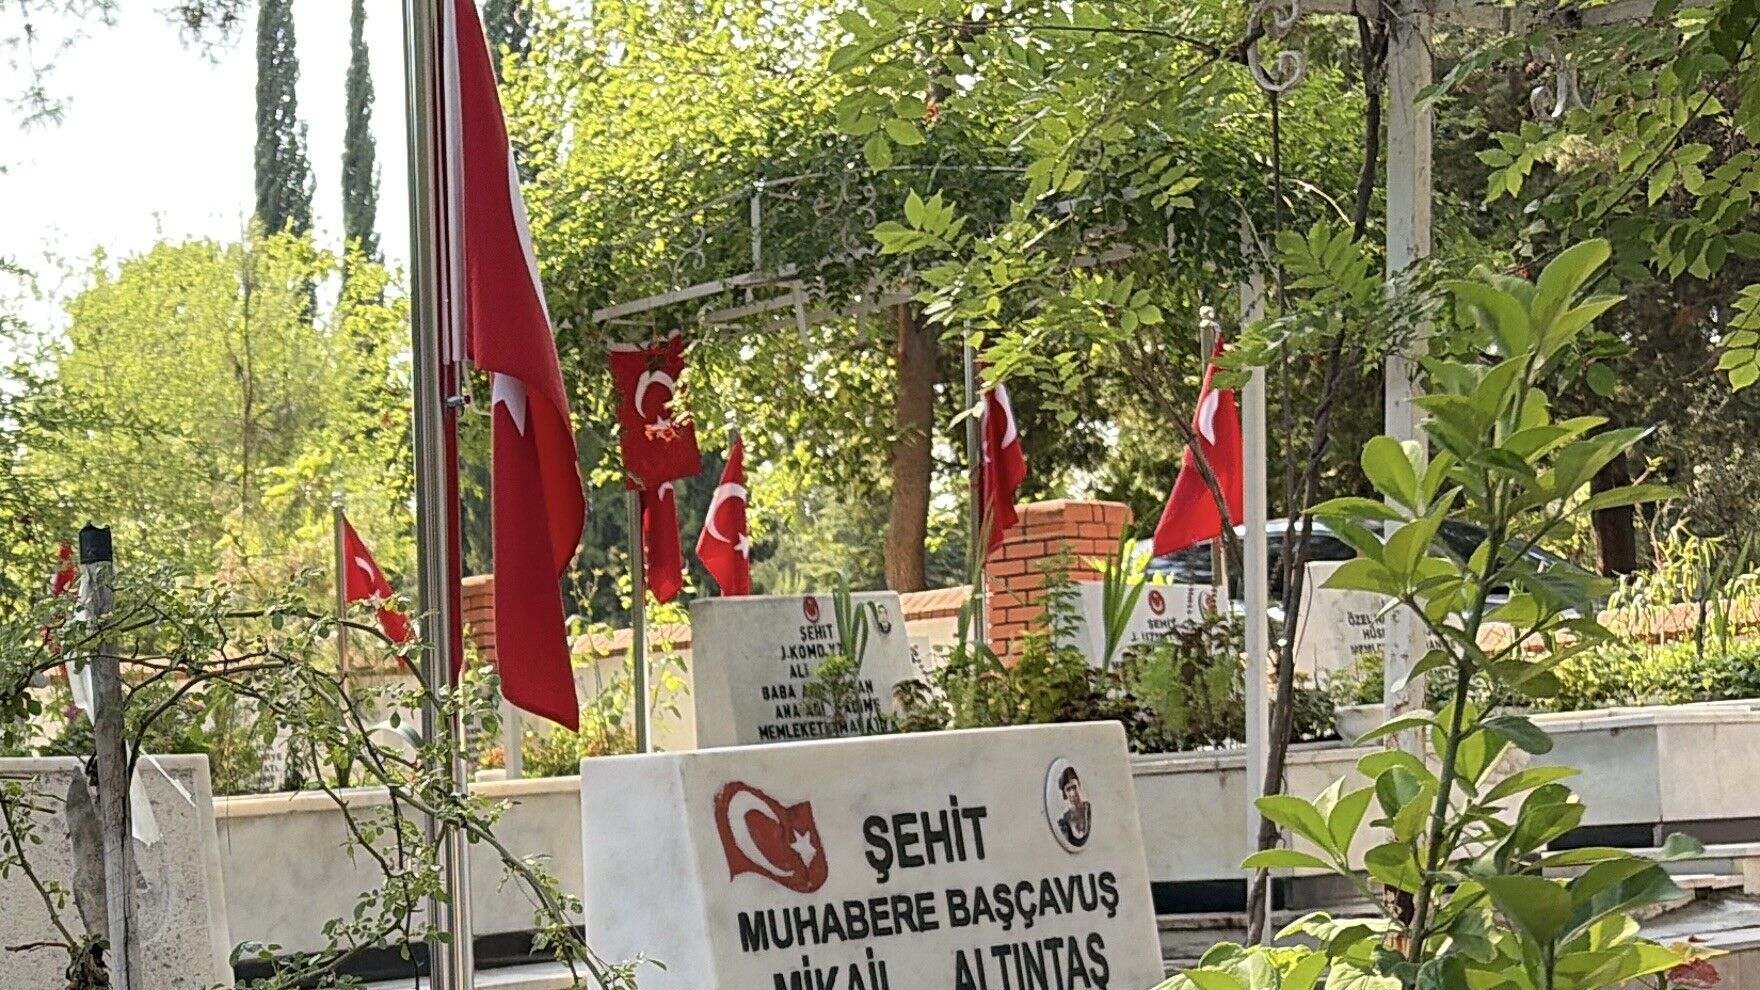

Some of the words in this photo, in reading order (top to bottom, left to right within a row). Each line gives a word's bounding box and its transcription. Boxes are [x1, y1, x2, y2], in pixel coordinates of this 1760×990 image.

[761, 684, 797, 701] BABA
[863, 795, 988, 884] ŞEHİT
[738, 889, 940, 953] MUHABERE
[946, 871, 1120, 931] BAŞÇAVUŞ
